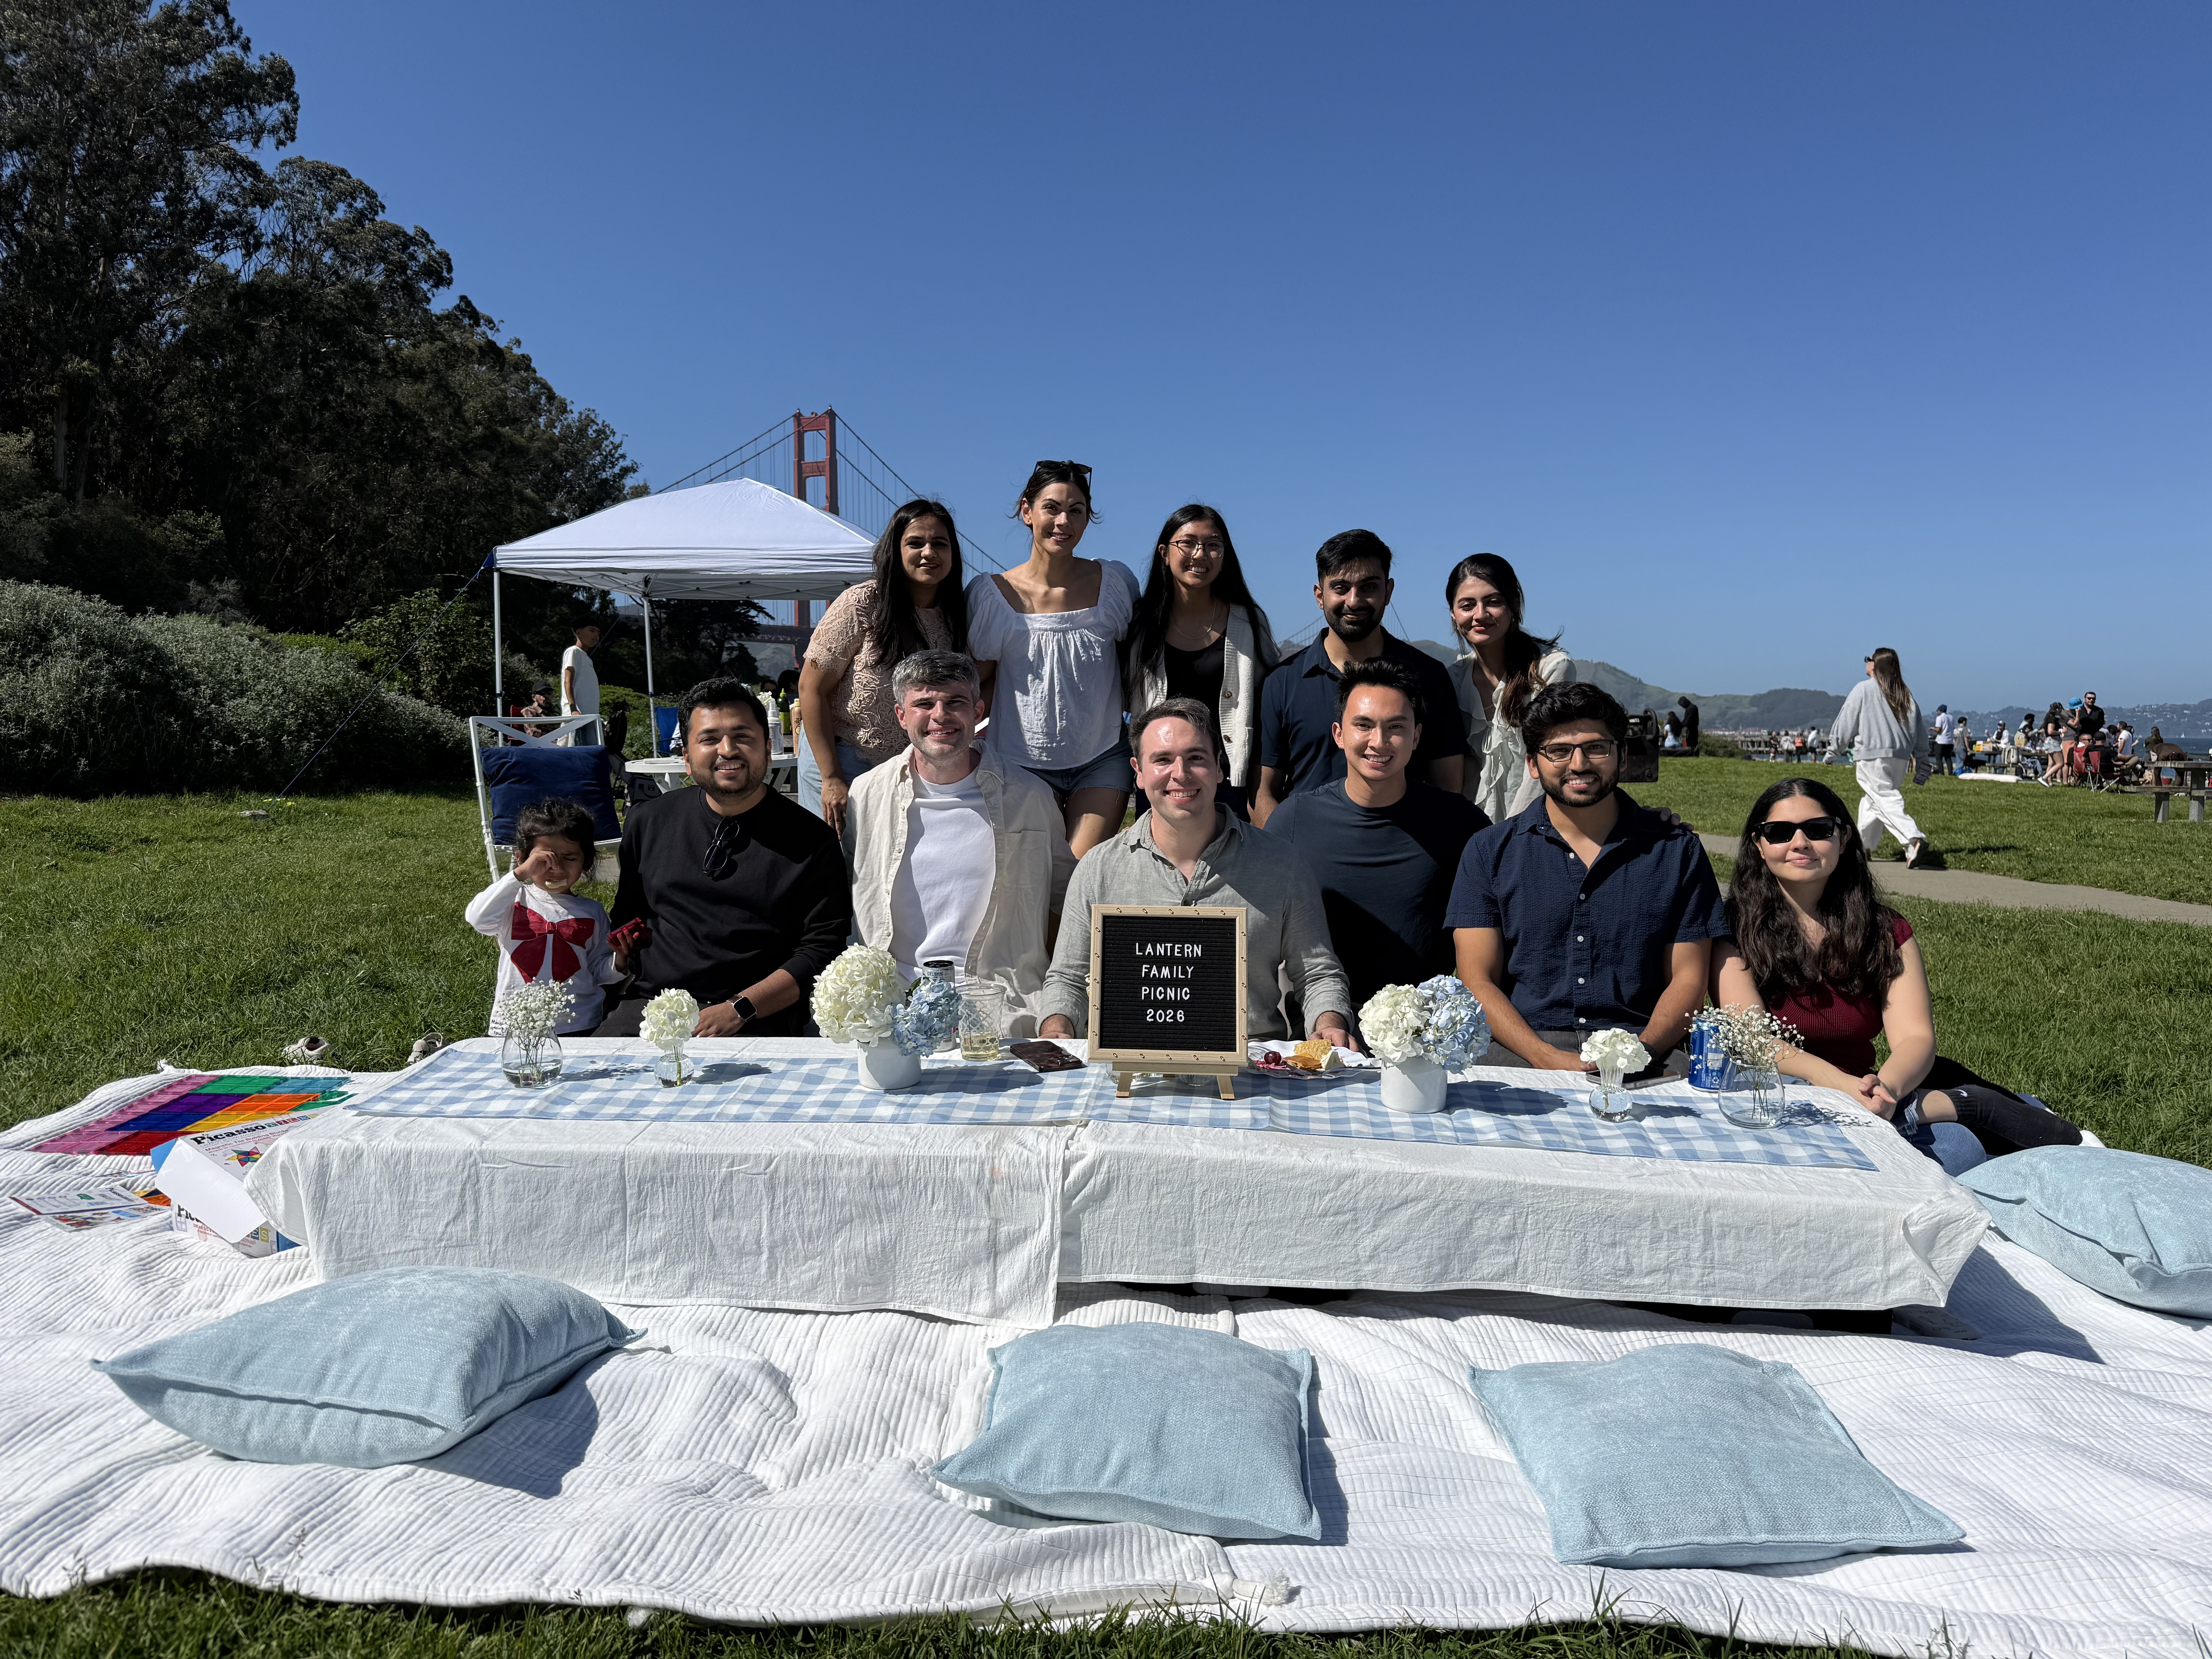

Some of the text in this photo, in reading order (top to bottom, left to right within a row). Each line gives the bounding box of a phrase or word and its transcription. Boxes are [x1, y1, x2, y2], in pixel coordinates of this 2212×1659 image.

[1136, 942, 1201, 958] LANTERN
[1142, 964, 1194, 979] FAMILY
[1142, 986, 1190, 1001] PICNIC
[1146, 1009, 1185, 1022] 2026
